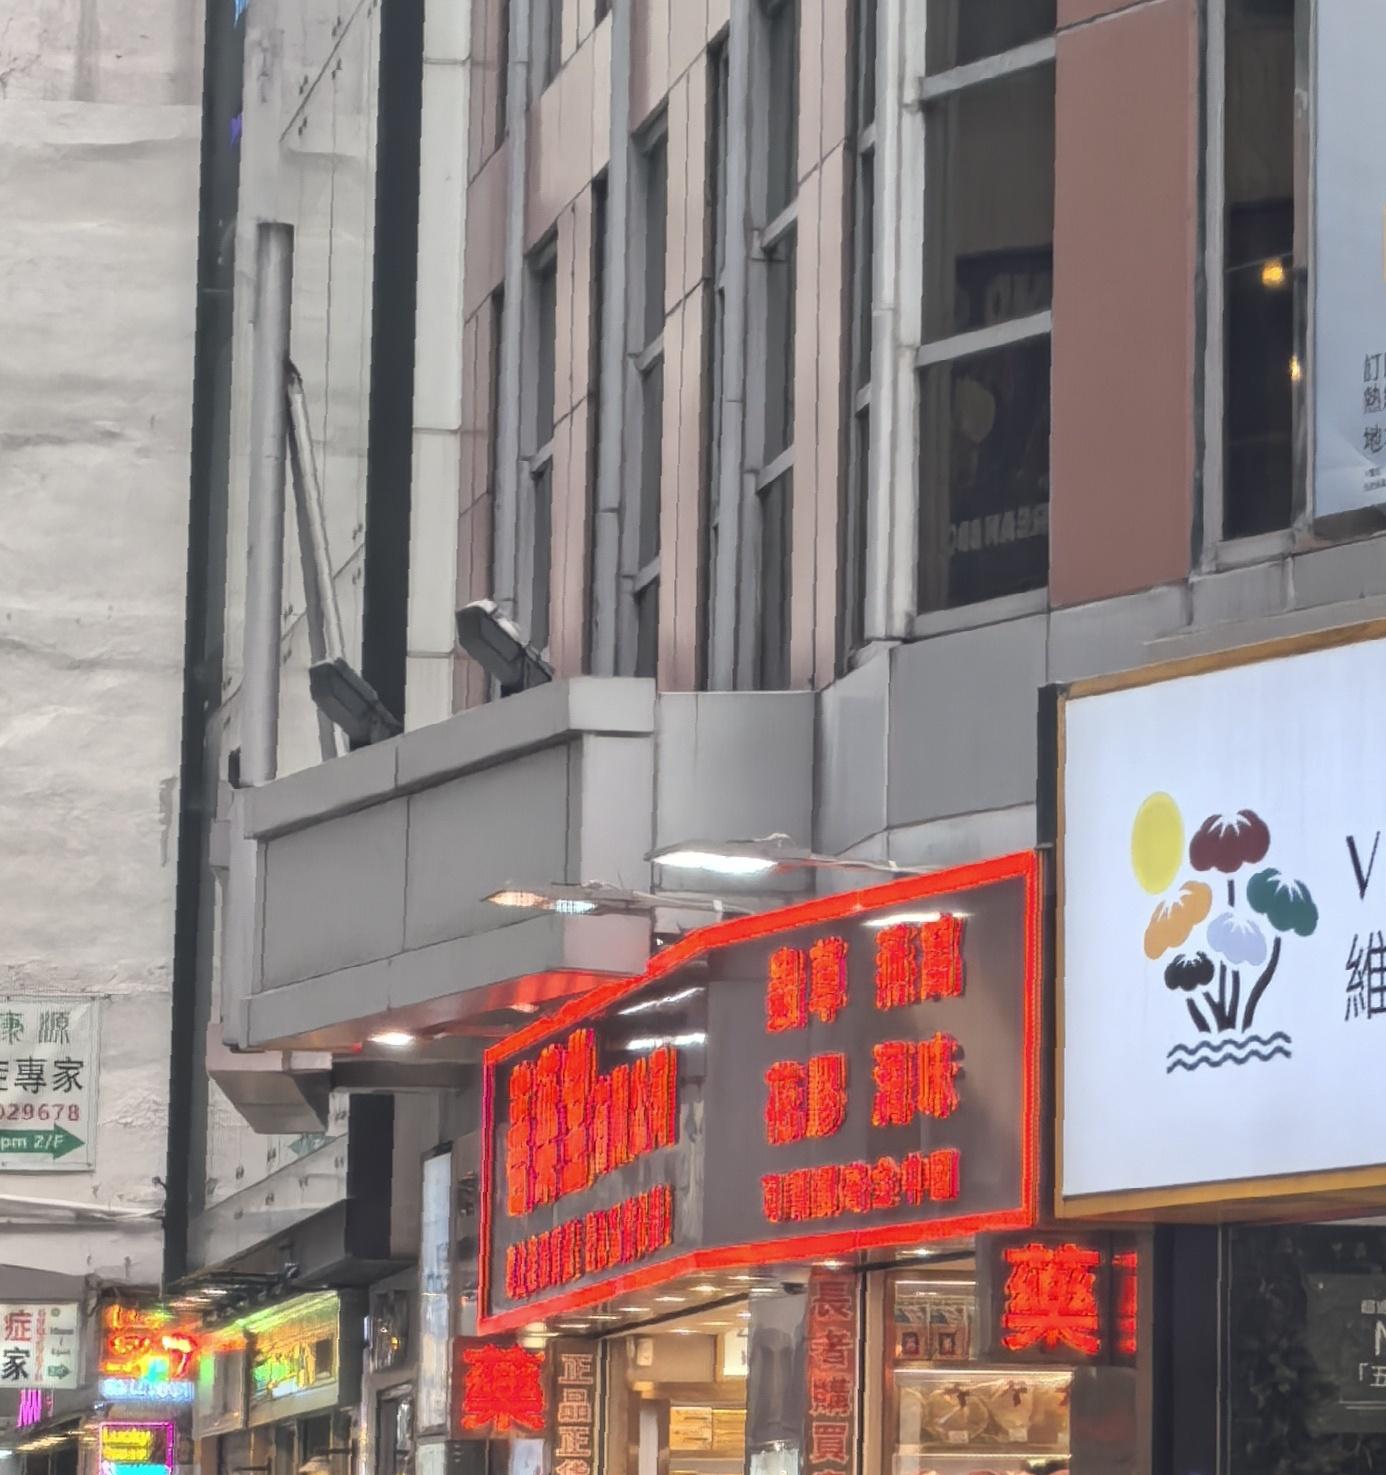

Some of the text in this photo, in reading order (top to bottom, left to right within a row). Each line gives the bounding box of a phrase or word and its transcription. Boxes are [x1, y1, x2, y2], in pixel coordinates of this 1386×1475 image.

[0, 1056, 84, 1094] 專家
[0, 1103, 80, 1121] 29678
[33, 1133, 65, 1149] 2/F
[4, 1309, 33, 1342] 症
[1, 1347, 31, 1380] 家
